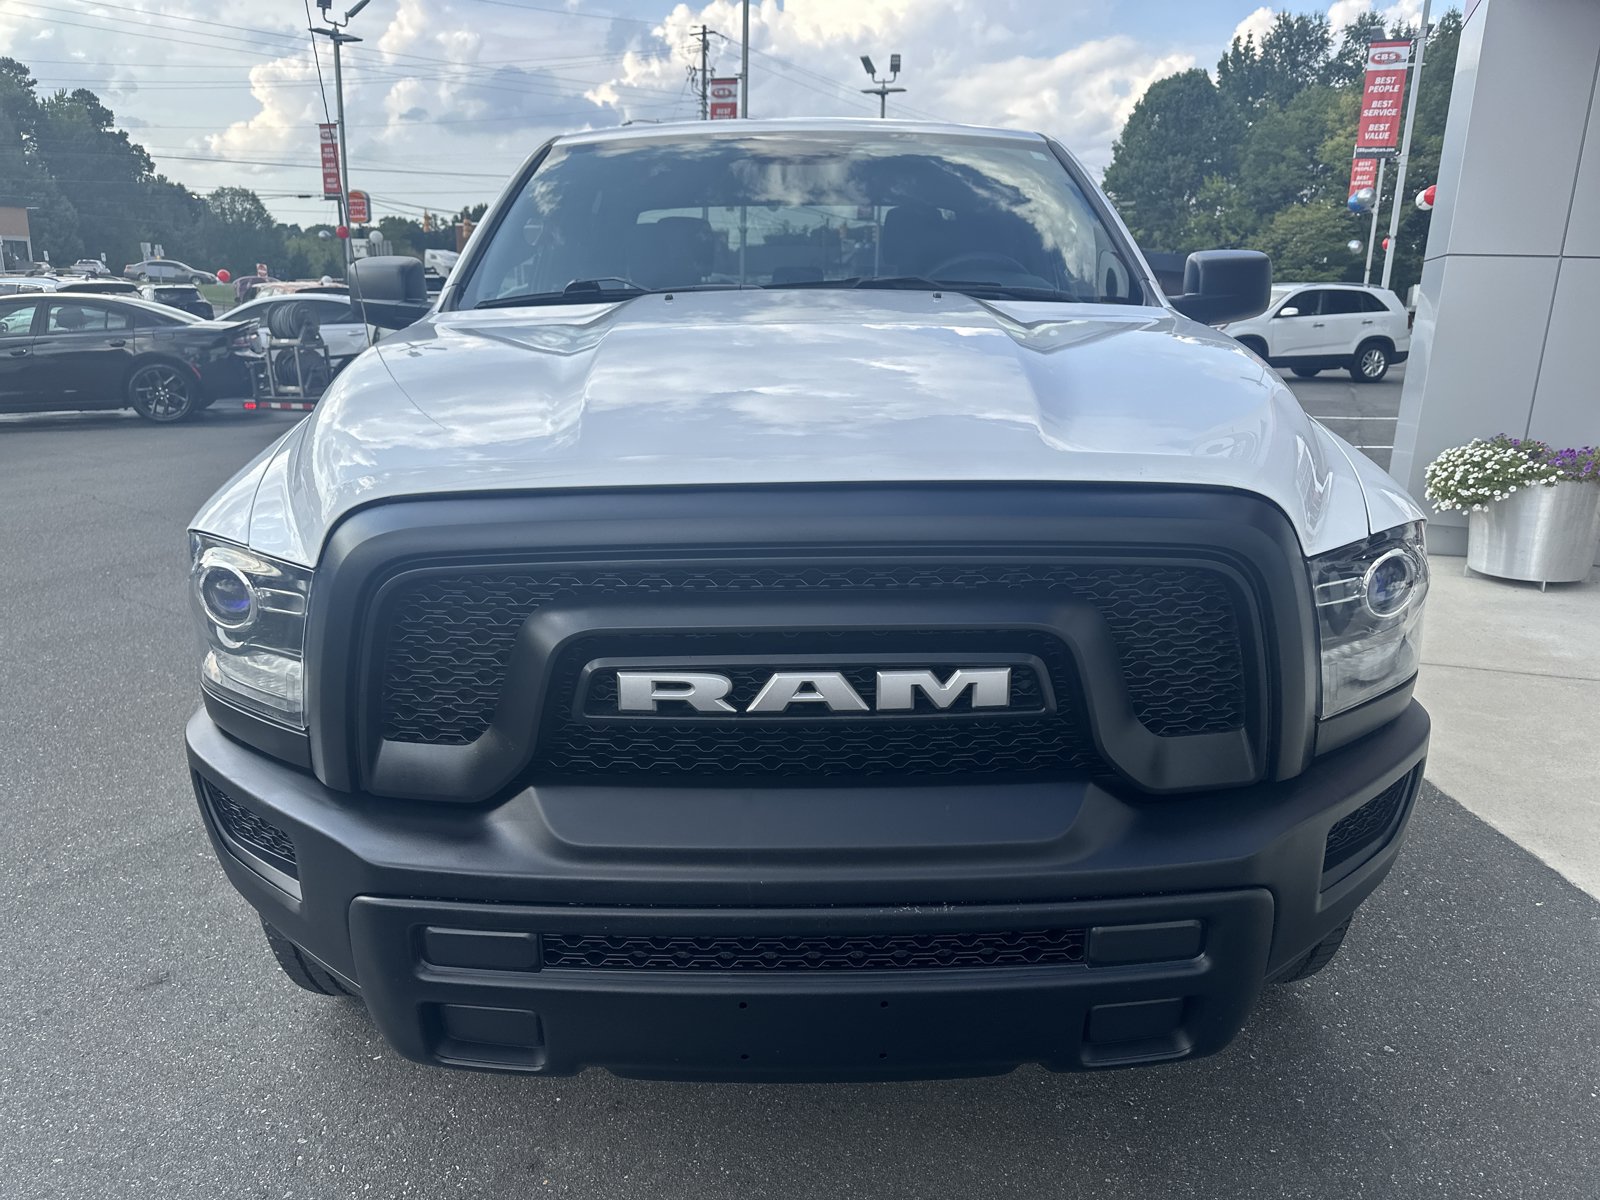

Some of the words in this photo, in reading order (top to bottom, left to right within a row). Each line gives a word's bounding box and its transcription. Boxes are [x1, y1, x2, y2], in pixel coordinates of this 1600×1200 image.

[1374, 76, 1396, 84] BEST
[1368, 84, 1400, 93] PEOPLE
[1371, 100, 1393, 108] BEST
[1363, 108, 1398, 117] SERVICE
[1368, 123, 1390, 131] BEST
[1364, 131, 1390, 140] VALUE
[616, 667, 1012, 713] RAM
